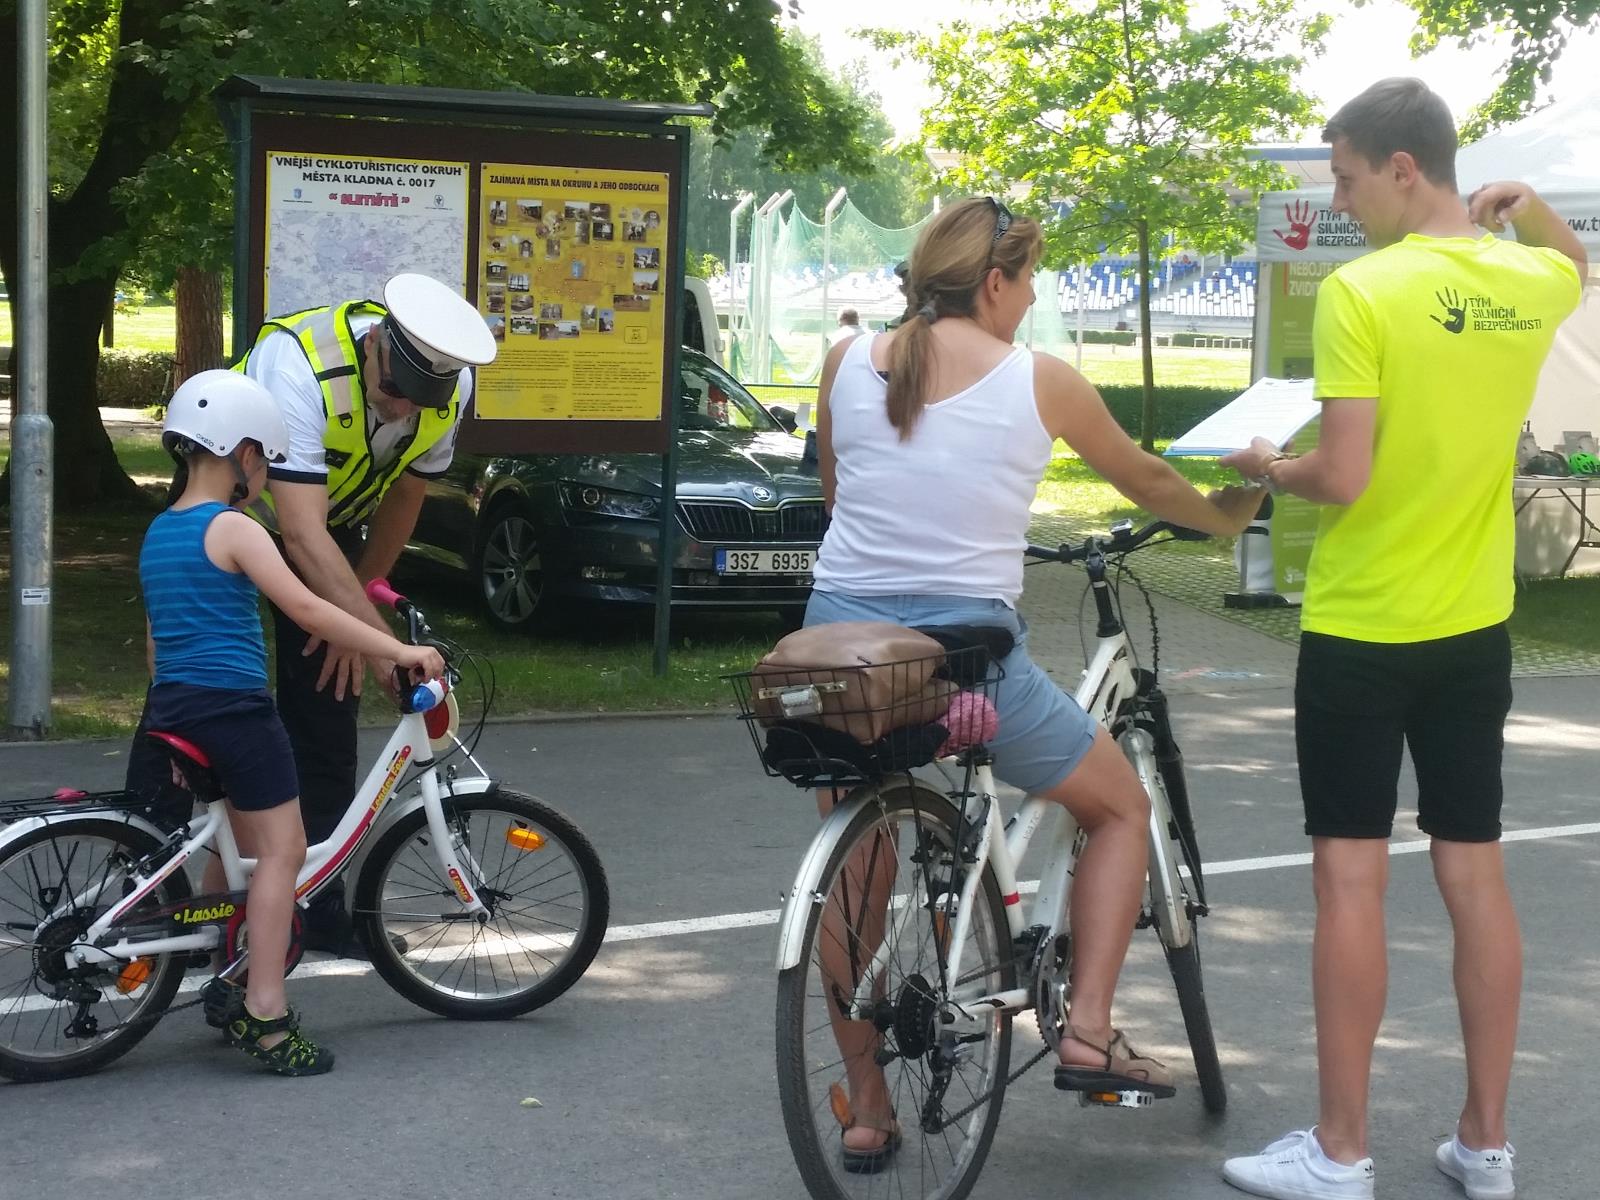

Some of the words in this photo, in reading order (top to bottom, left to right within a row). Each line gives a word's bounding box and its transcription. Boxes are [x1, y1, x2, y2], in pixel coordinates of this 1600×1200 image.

[275, 155, 313, 169] VNĚJŠÍ
[315, 158, 419, 174] CYKLOTURISTICKÝ
[421, 165, 462, 176] OKRUH
[302, 170, 341, 183] MĚSTA
[344, 174, 394, 186] KLADNA
[408, 178, 436, 188] 0017
[489, 173, 526, 185] ZAJÍMAVÁ
[527, 176, 549, 187] MÍSTA
[550, 178, 561, 187] NA
[562, 178, 592, 189] OKRUHU
[593, 181, 599, 189] A
[599, 181, 617, 190] JEHO
[1319, 206, 1342, 221] TÝM
[1316, 234, 1367, 247] BEZPEČN
[1468, 294, 1492, 308] TÝM
[1471, 305, 1517, 320] SILNIČNÍ
[1473, 318, 1543, 331] BEZPEČNOSTI
[730, 553, 760, 570] 3SZ
[771, 552, 810, 570] 6935
[182, 902, 236, 925] Lassie
